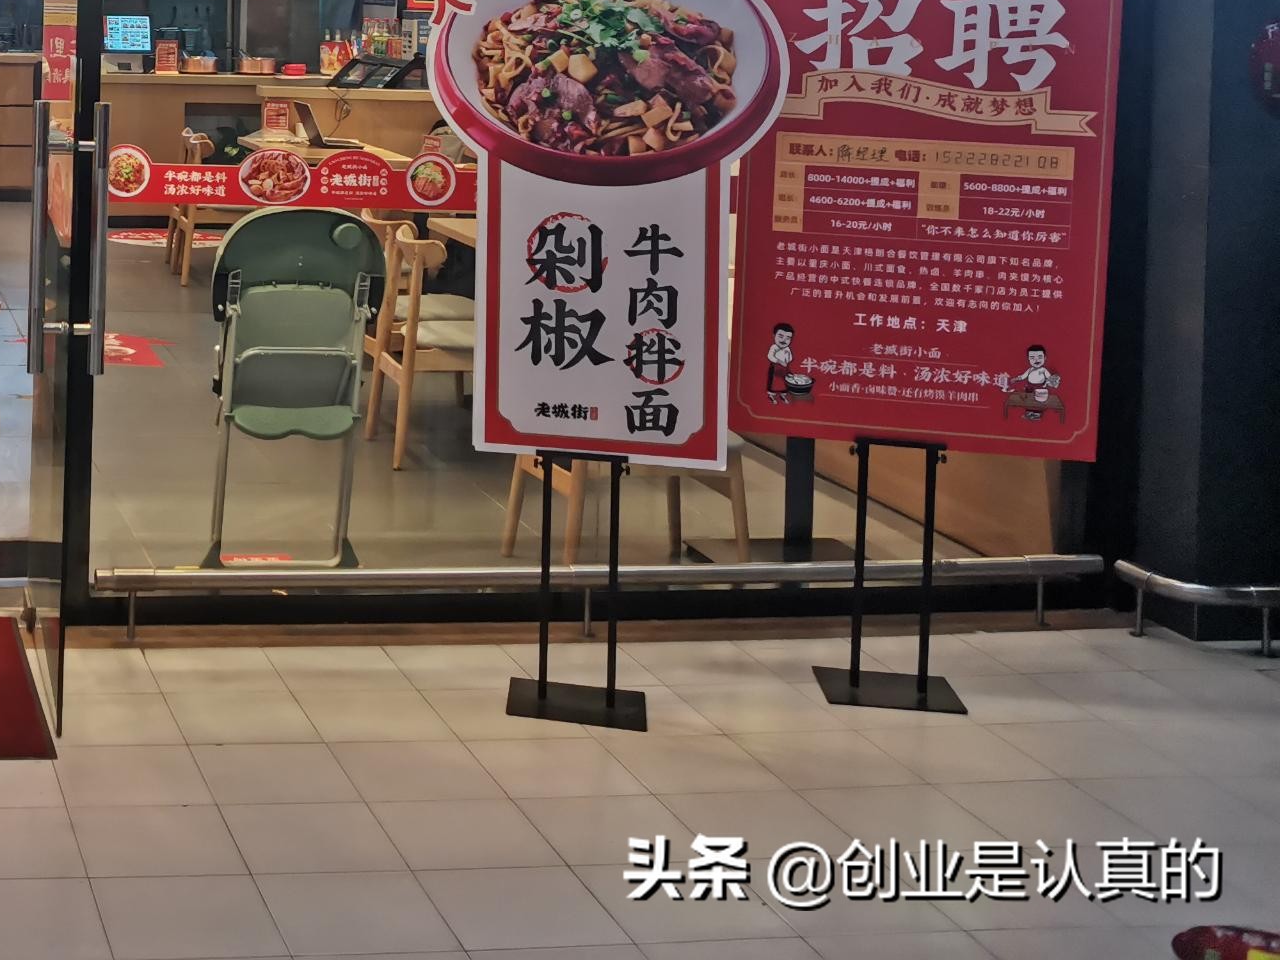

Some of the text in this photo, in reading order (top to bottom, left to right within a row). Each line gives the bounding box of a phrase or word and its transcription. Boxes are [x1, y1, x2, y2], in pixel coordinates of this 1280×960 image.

[817, 74, 1038, 117] 加入我们·成就梦想
[514, 222, 616, 371] 剁椒
[622, 223, 685, 437] 牛肉拌面
[853, 313, 968, 334] 工作地点：天津
[870, 342, 942, 360] 老城街小面
[534, 401, 589, 421] 老城街
